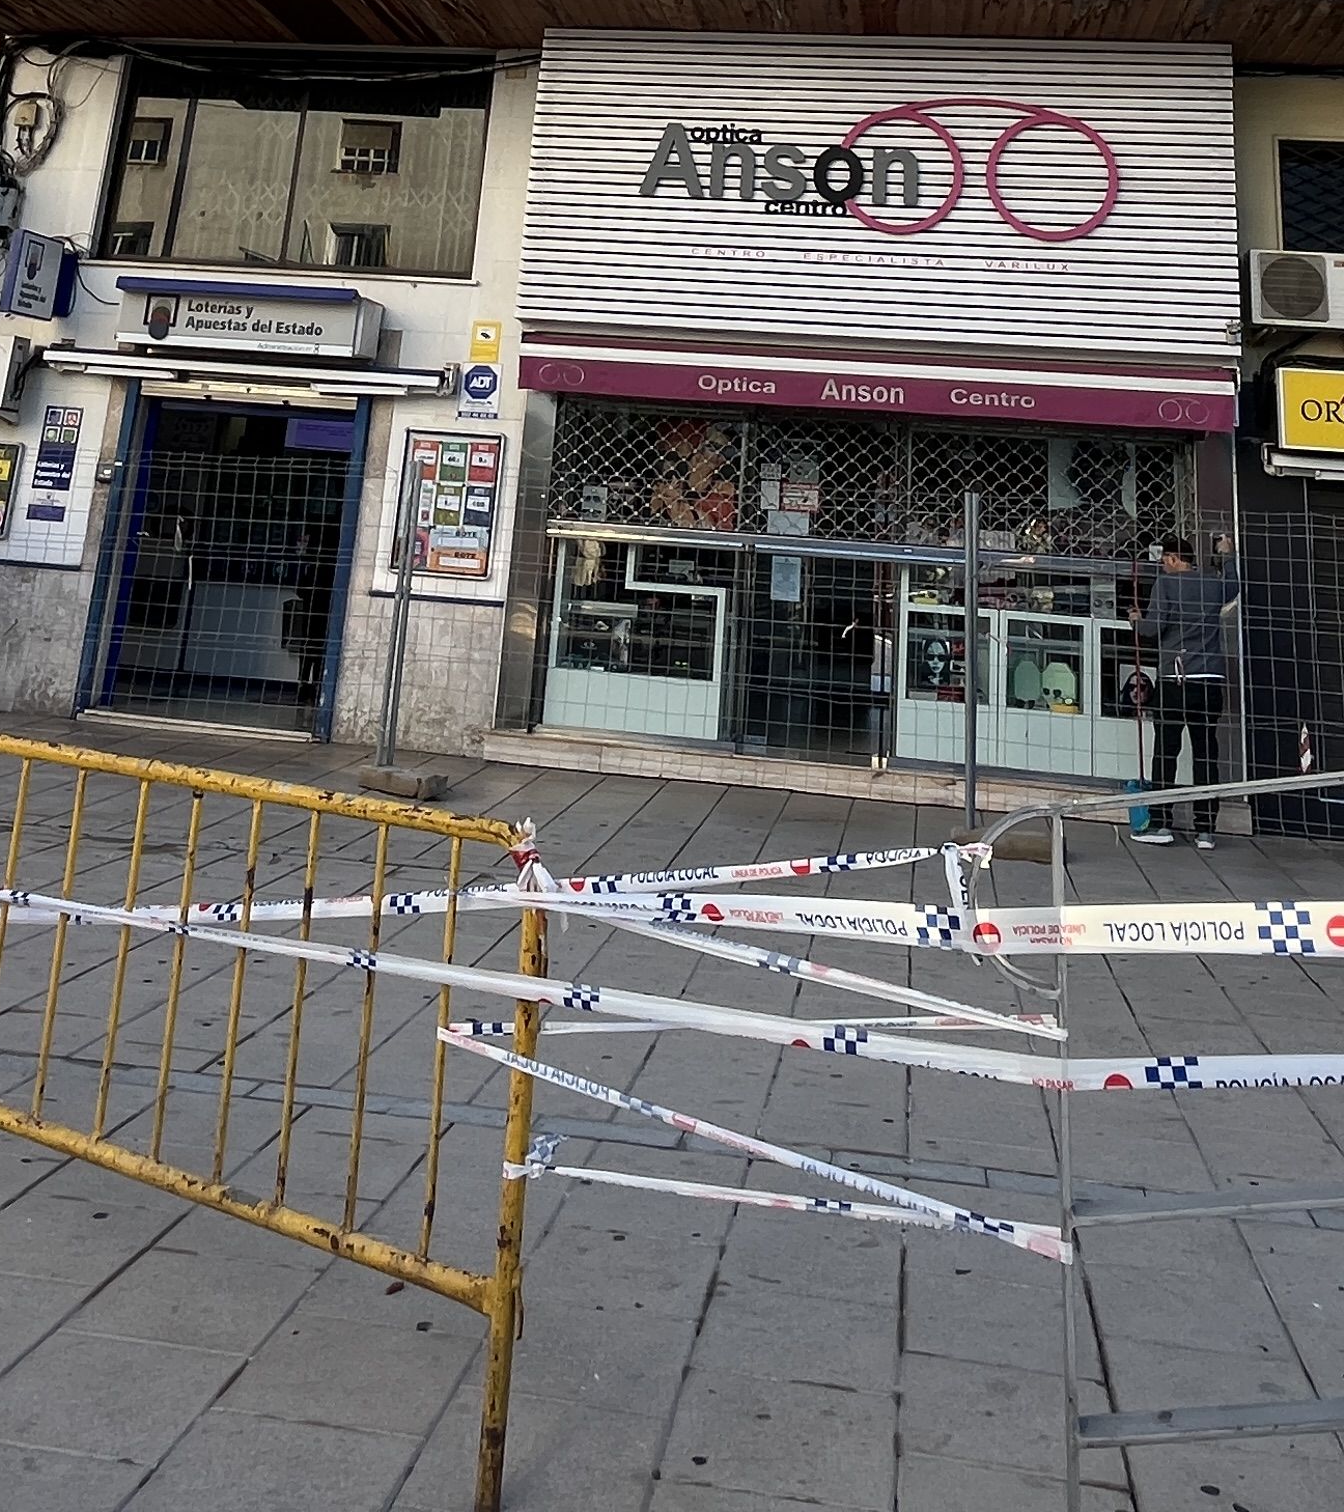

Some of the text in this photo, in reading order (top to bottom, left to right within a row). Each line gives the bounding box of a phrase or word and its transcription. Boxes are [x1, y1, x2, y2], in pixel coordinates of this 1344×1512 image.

[691, 123, 762, 144] optica
[639, 122, 919, 207] Anson
[765, 200, 847, 215] centro
[691, 248, 1069, 271] CENTRO ESPECIALISTA VARILUX
[188, 300, 254, 319] Loterías y
[186, 316, 323, 336] Apuestas del Estado
[469, 376, 493, 388] ADT
[698, 374, 1036, 408] Optica Anson Centro
[795, 913, 908, 936] POLICÍA LOCAL
[1103, 921, 1244, 945] POLICÍA LOCAL
